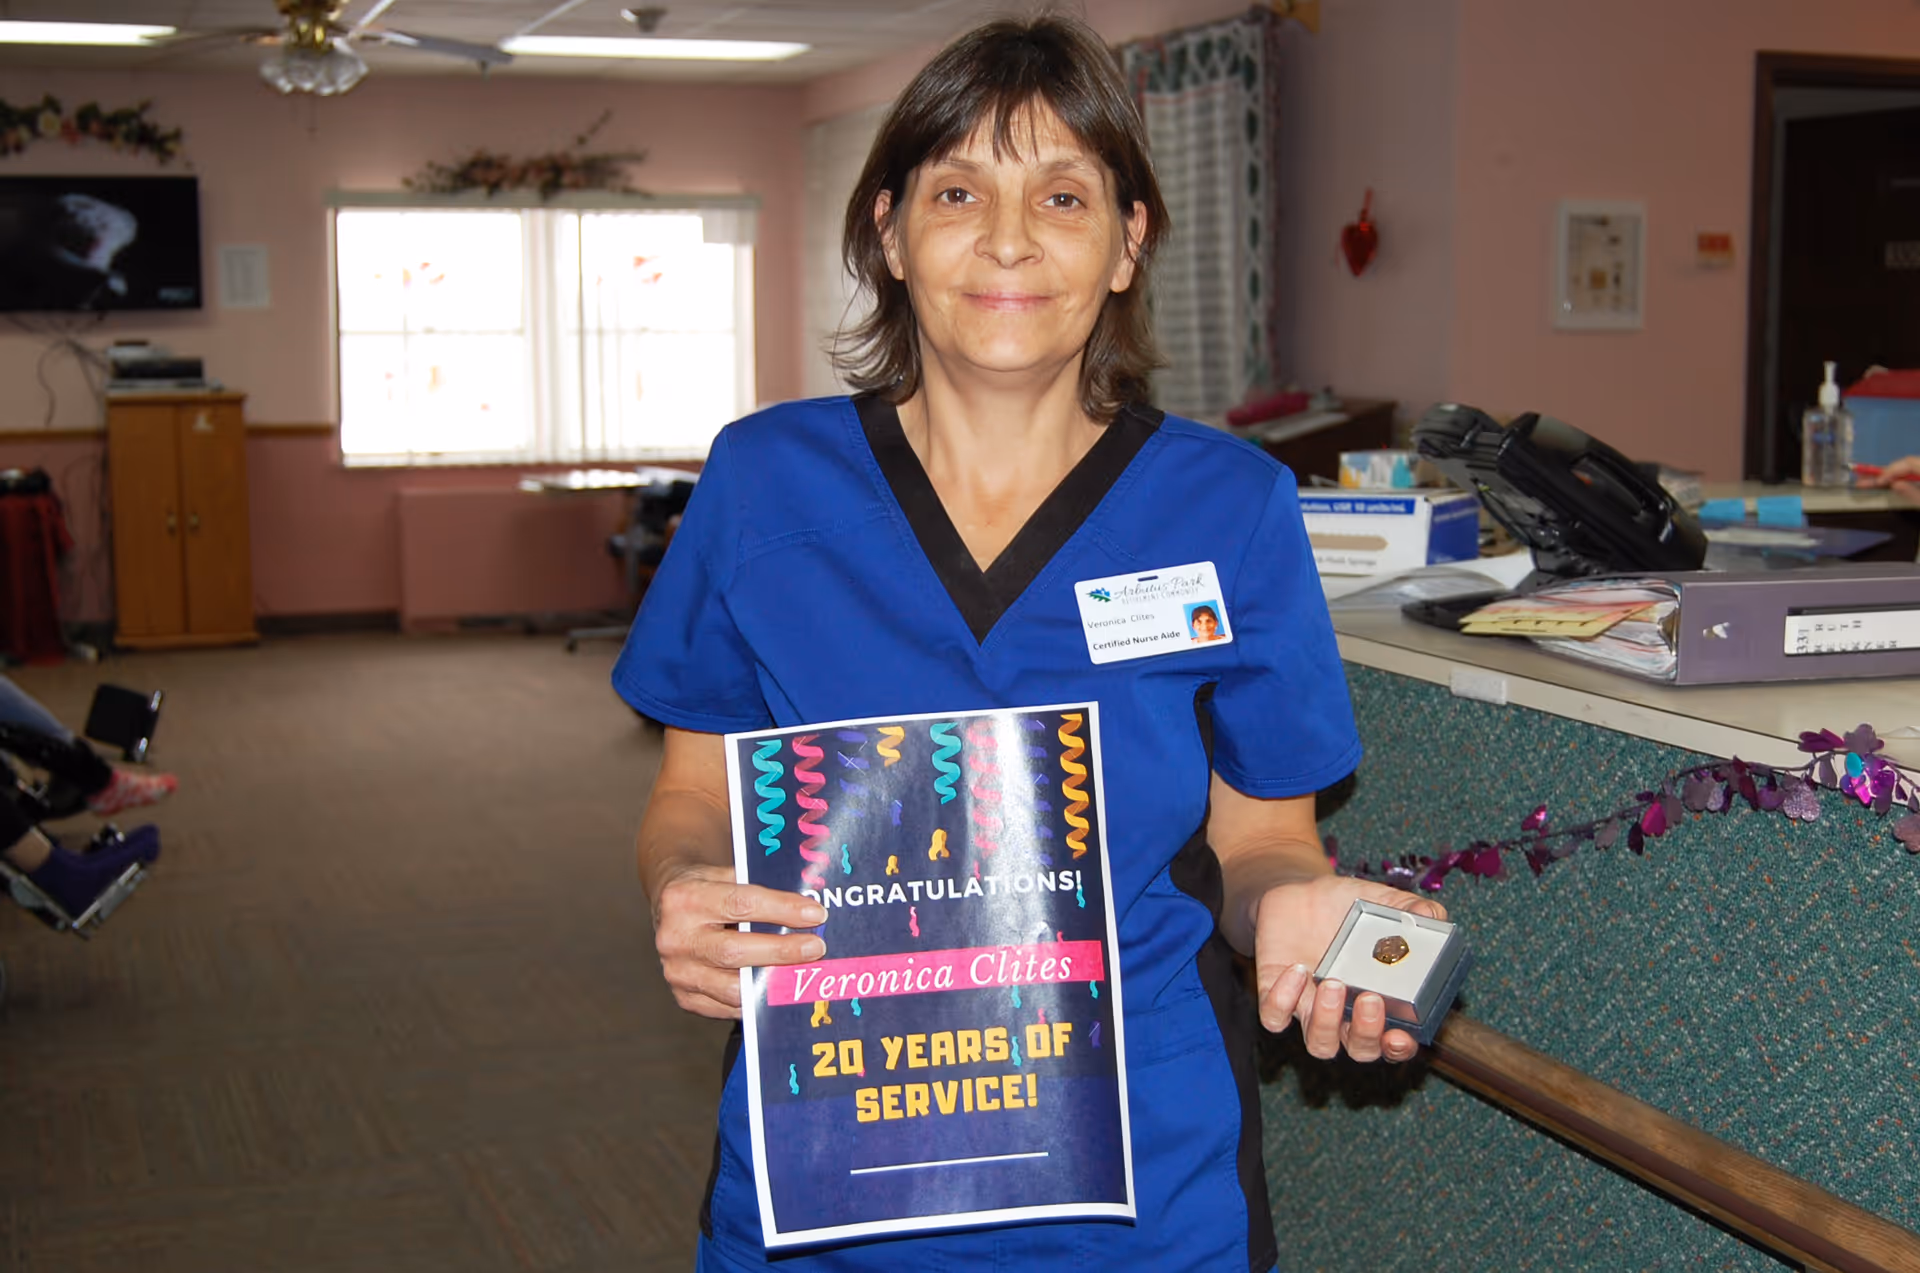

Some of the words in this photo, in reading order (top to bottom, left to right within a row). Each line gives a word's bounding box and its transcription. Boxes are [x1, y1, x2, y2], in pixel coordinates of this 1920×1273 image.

[1114, 582, 1168, 599] Arbutus
[1170, 573, 1205, 591] Park
[1088, 617, 1126, 629] Veronica
[1131, 613, 1155, 623] Clites
[1093, 637, 1131, 651] Certified
[1133, 634, 1159, 644] Nurse
[1161, 630, 1181, 640] Aide
[801, 870, 1083, 909] ONGRATULATIONS!
[793, 958, 954, 1001] Veronica
[969, 944, 1073, 987] Clites
[812, 1039, 864, 1077] 20
[881, 1027, 1009, 1070] YEARS
[1026, 1022, 1073, 1059] OF
[855, 1073, 1038, 1123] SERVICE!
